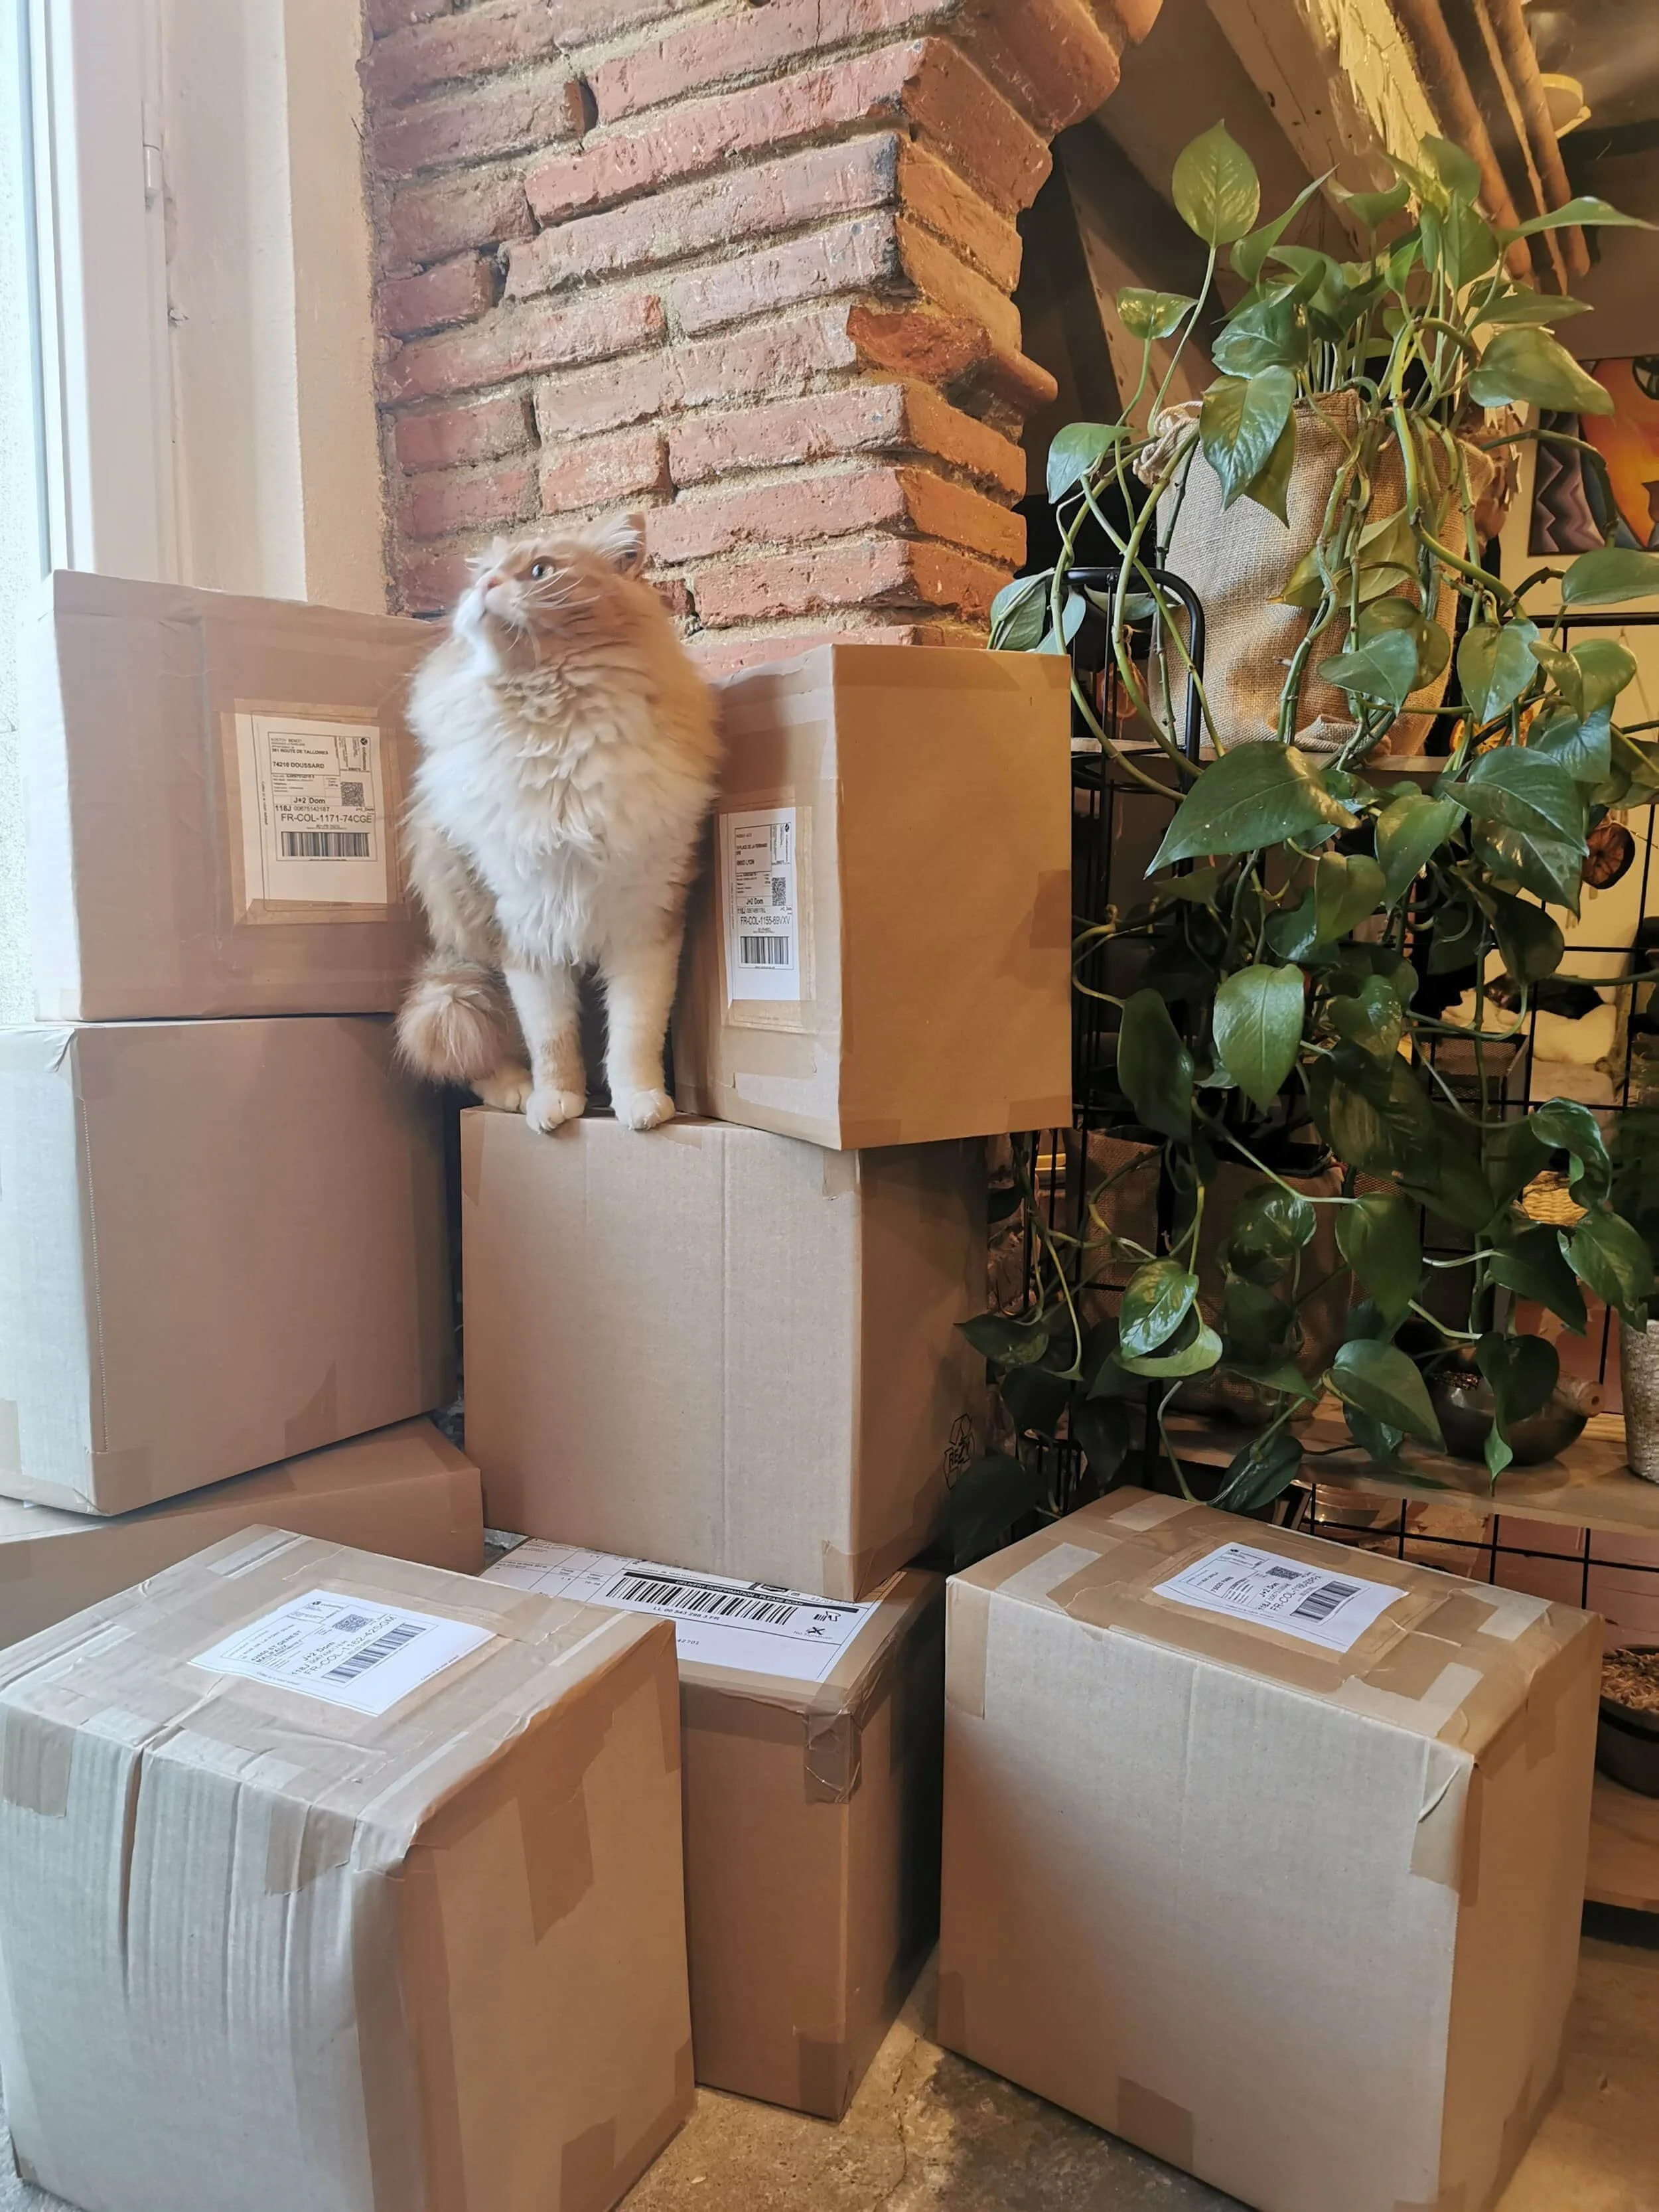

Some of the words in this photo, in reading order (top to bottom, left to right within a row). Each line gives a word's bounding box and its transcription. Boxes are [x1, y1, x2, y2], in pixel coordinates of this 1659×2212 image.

[281, 813, 372, 823] FR-COL-1171-74CGE
[706, 1585, 755, 1597] CONFIRMATION
[317, 1642, 335, 1653] Dom
